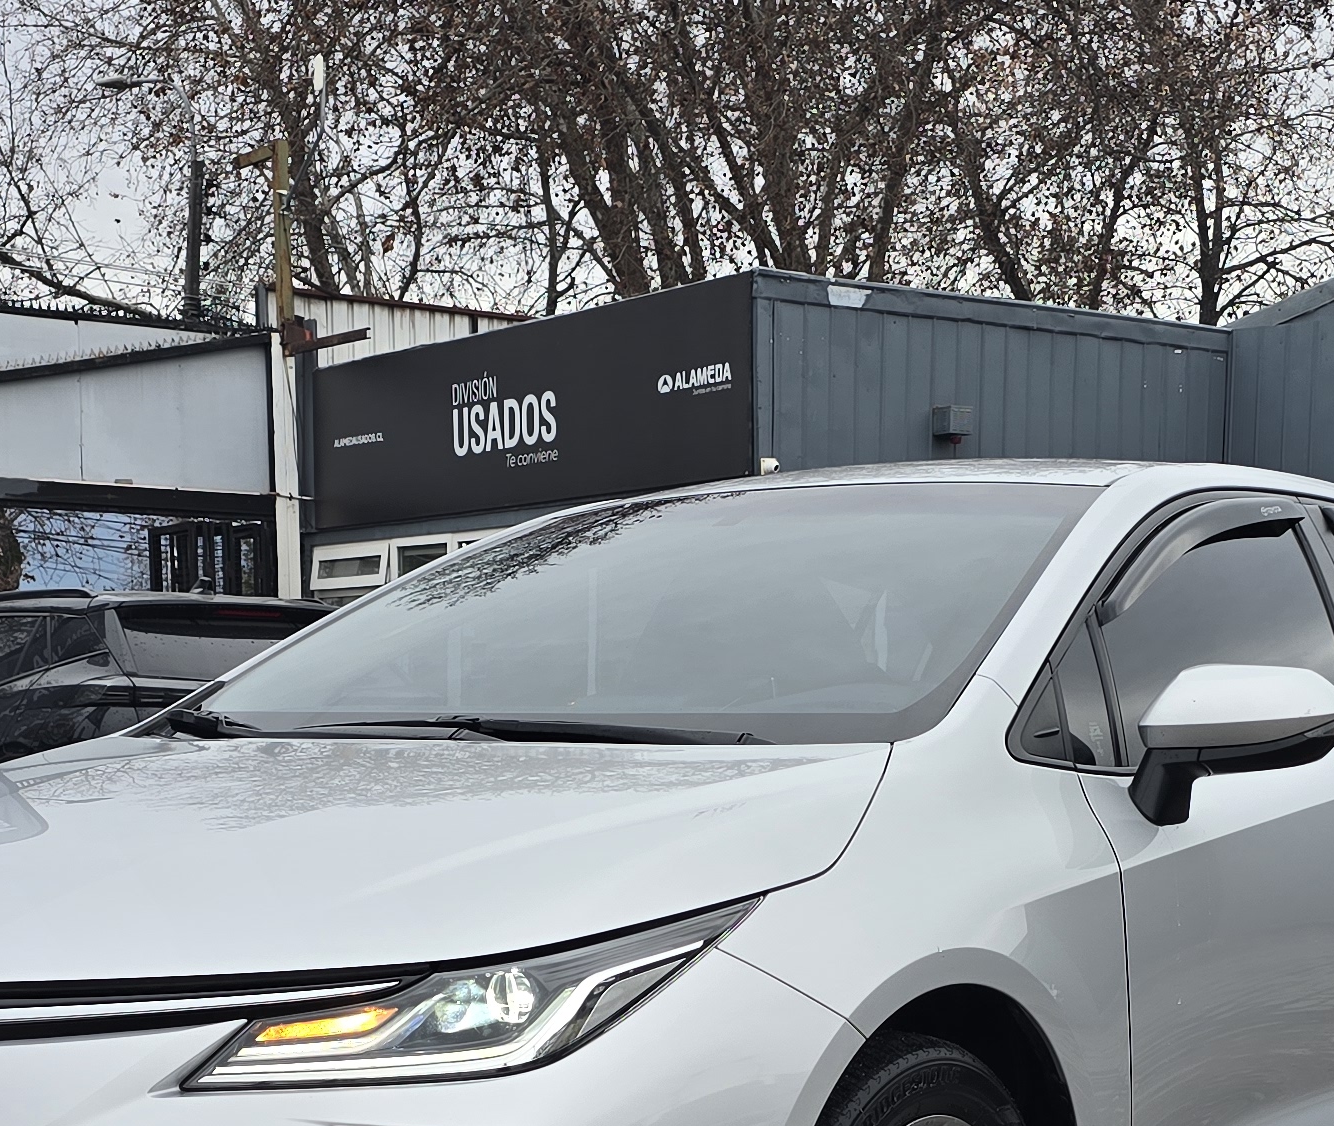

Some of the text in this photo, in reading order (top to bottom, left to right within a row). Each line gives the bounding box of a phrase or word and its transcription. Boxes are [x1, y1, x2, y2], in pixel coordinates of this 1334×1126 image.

[451, 370, 497, 406] DIVISIÓN
[673, 361, 732, 391] ALAMEDA
[452, 390, 557, 457] USADOS
[505, 448, 559, 468] Te conviene
